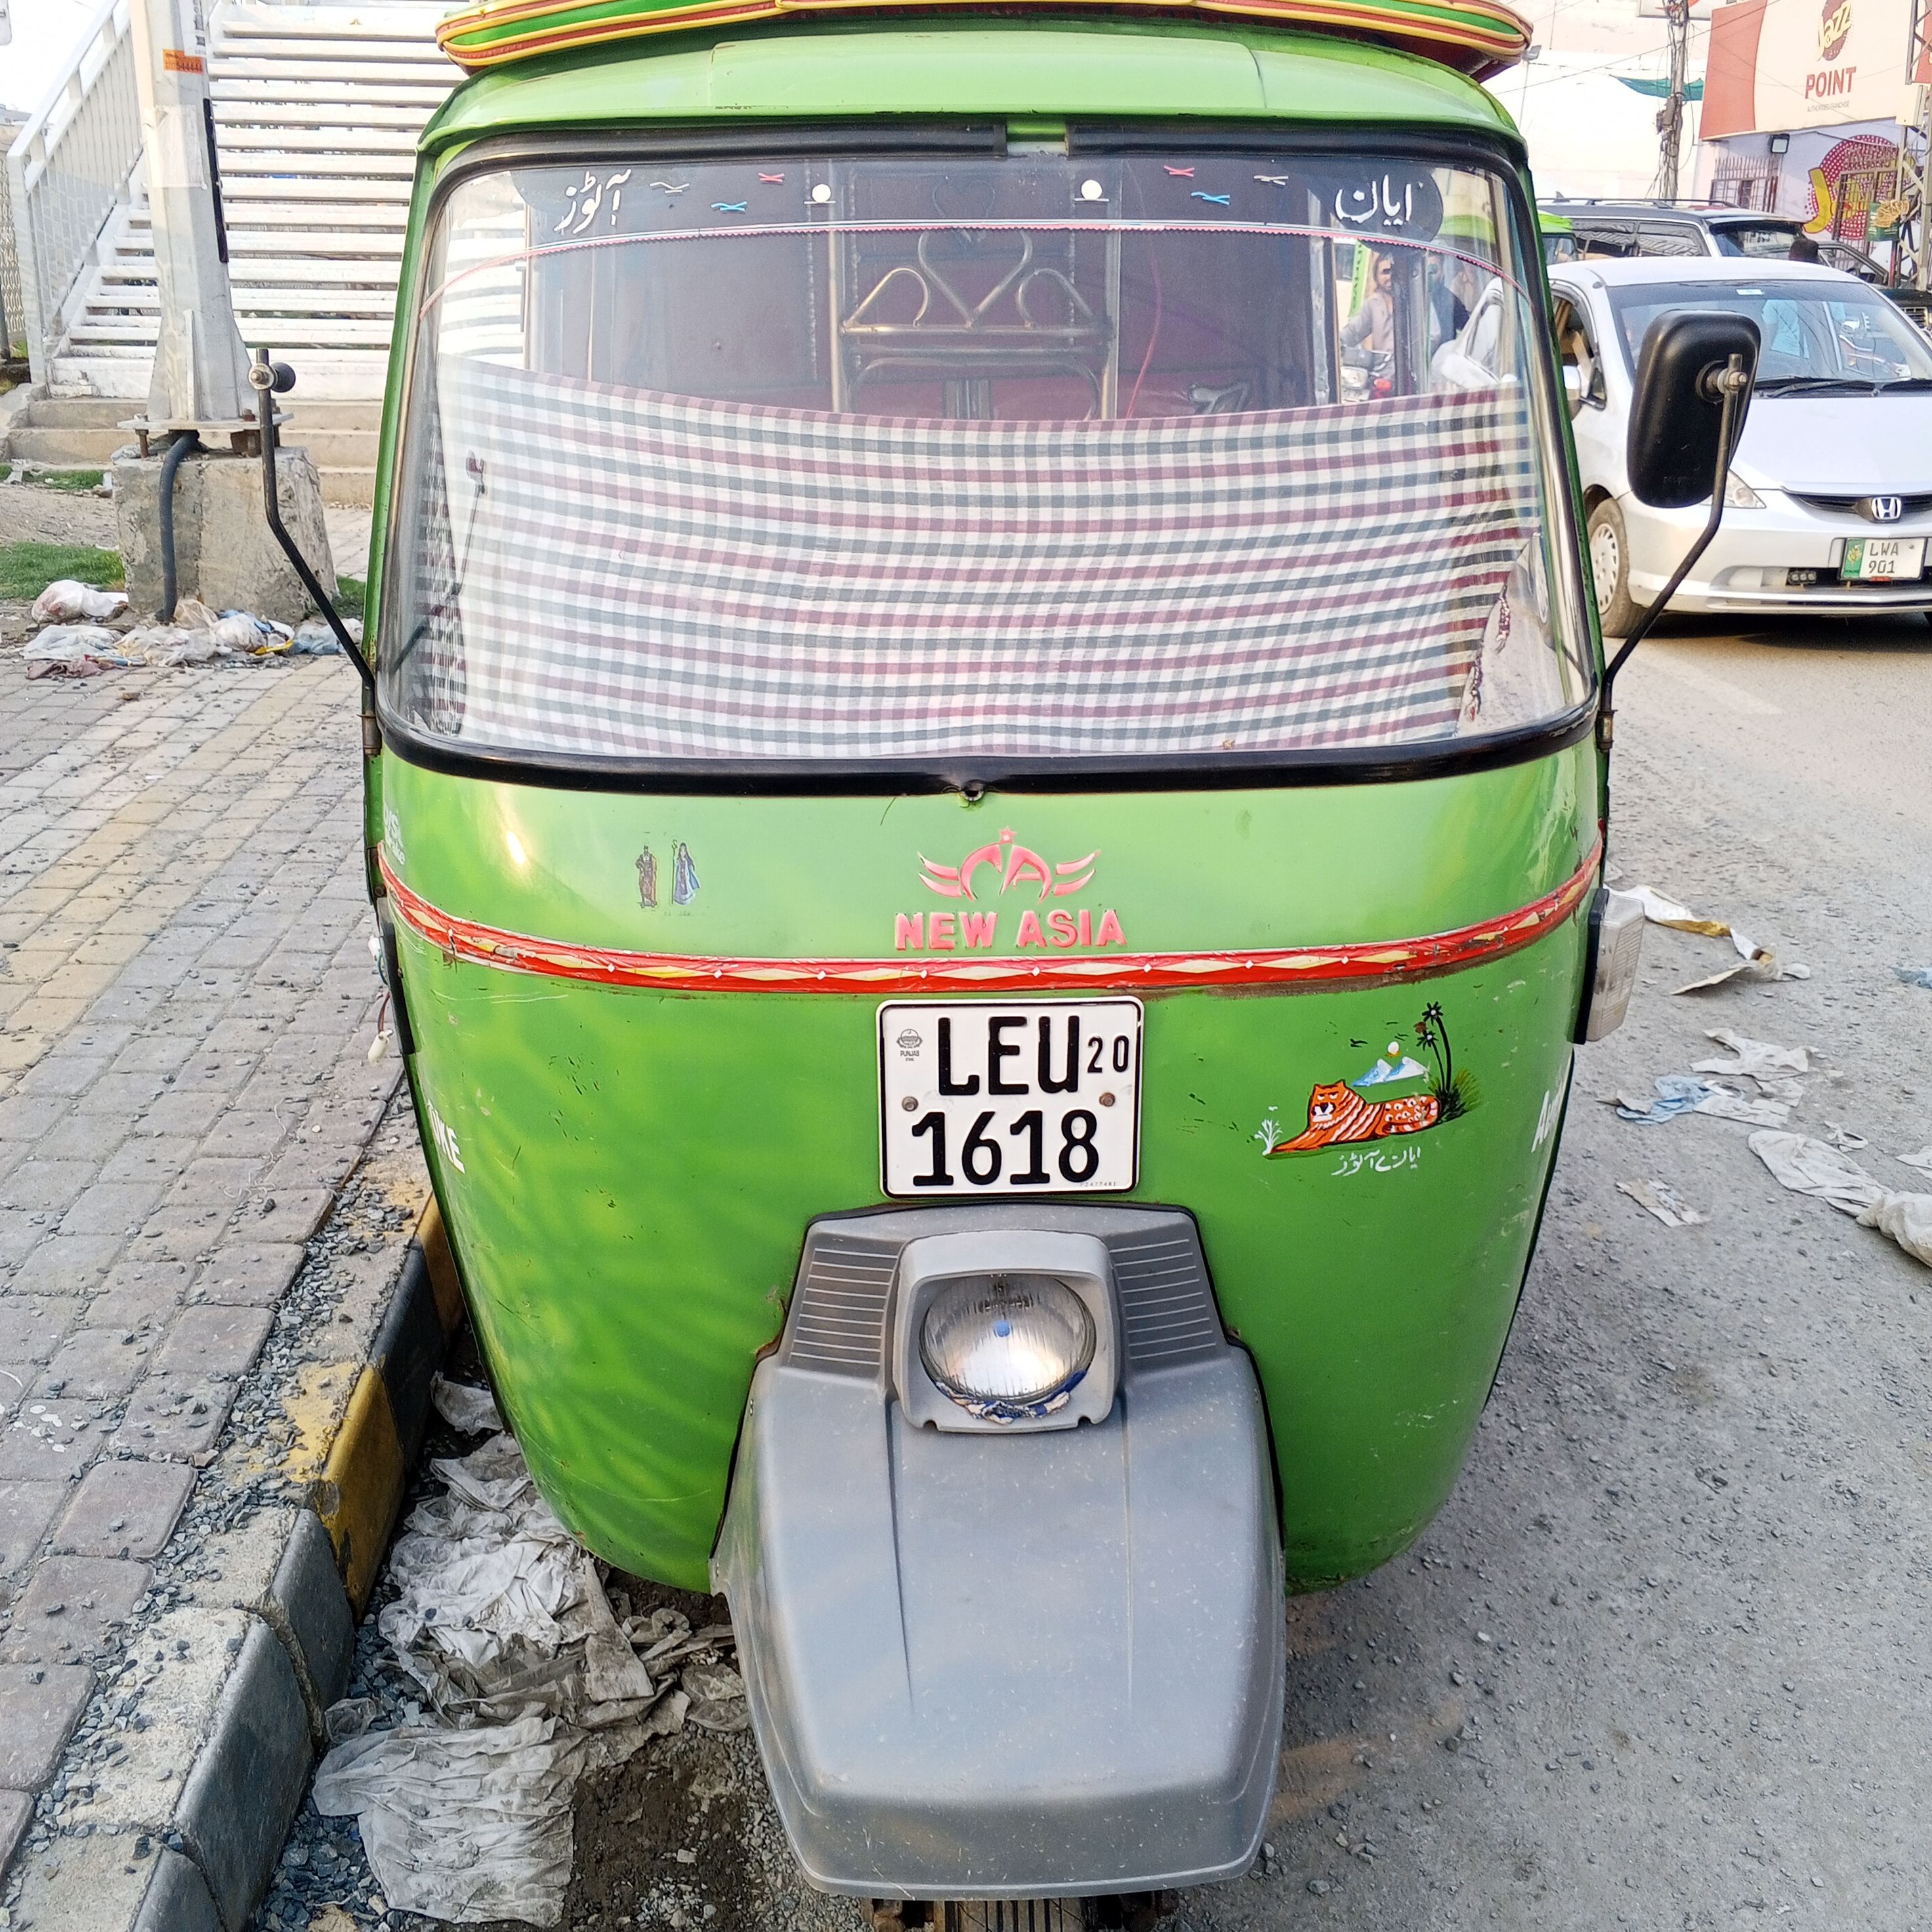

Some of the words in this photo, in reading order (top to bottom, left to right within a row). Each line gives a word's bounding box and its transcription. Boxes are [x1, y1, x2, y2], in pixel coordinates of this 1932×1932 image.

[1805, 66, 1857, 99] POINT
[1868, 560, 1895, 574] 901
[1870, 542, 1899, 556] LWA
[895, 912, 998, 950] NEW
[1016, 910, 1127, 948] ASIA
[938, 1015, 1080, 1095] LEU
[1087, 1035, 1129, 1074] 20
[912, 1109, 1099, 1186] 1618
